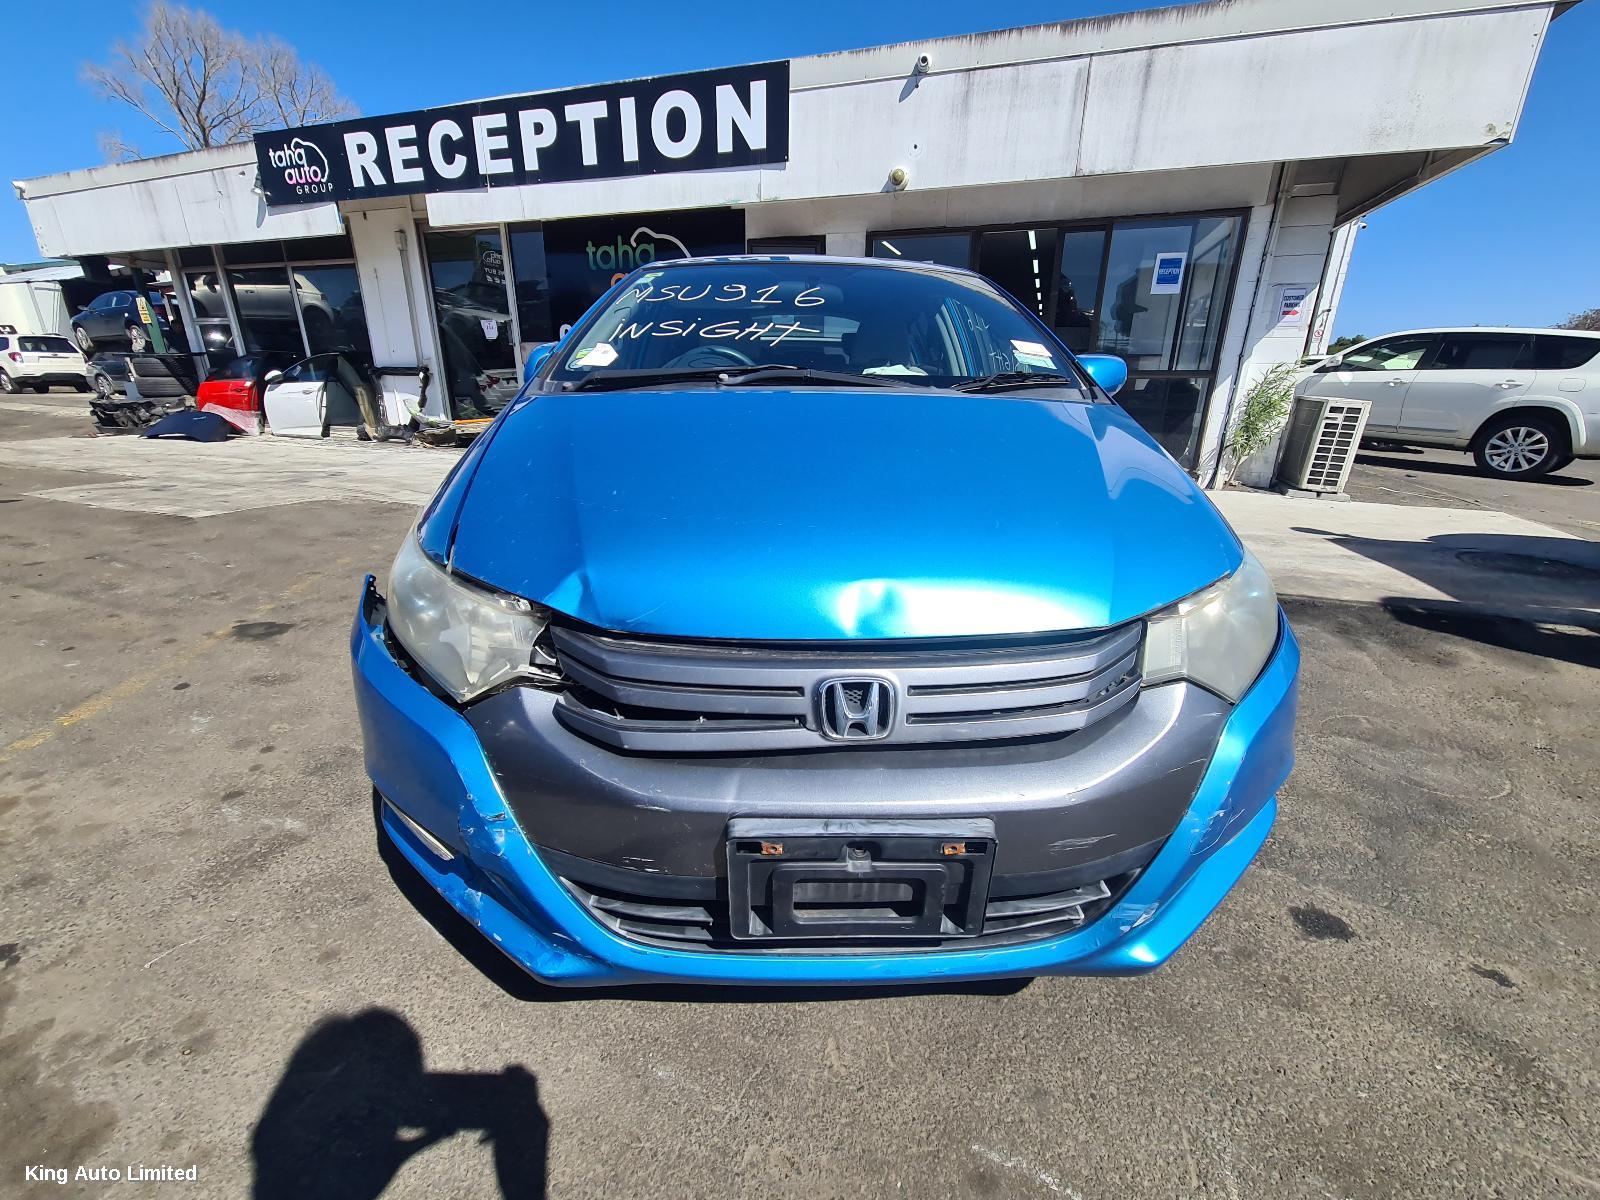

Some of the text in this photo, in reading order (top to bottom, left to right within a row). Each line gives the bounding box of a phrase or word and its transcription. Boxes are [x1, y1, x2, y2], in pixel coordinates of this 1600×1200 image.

[343, 80, 767, 188] RECEPTION
[269, 144, 307, 168] taha
[285, 165, 321, 185] auto
[296, 183, 333, 195] GROUP
[586, 235, 655, 270] taha
